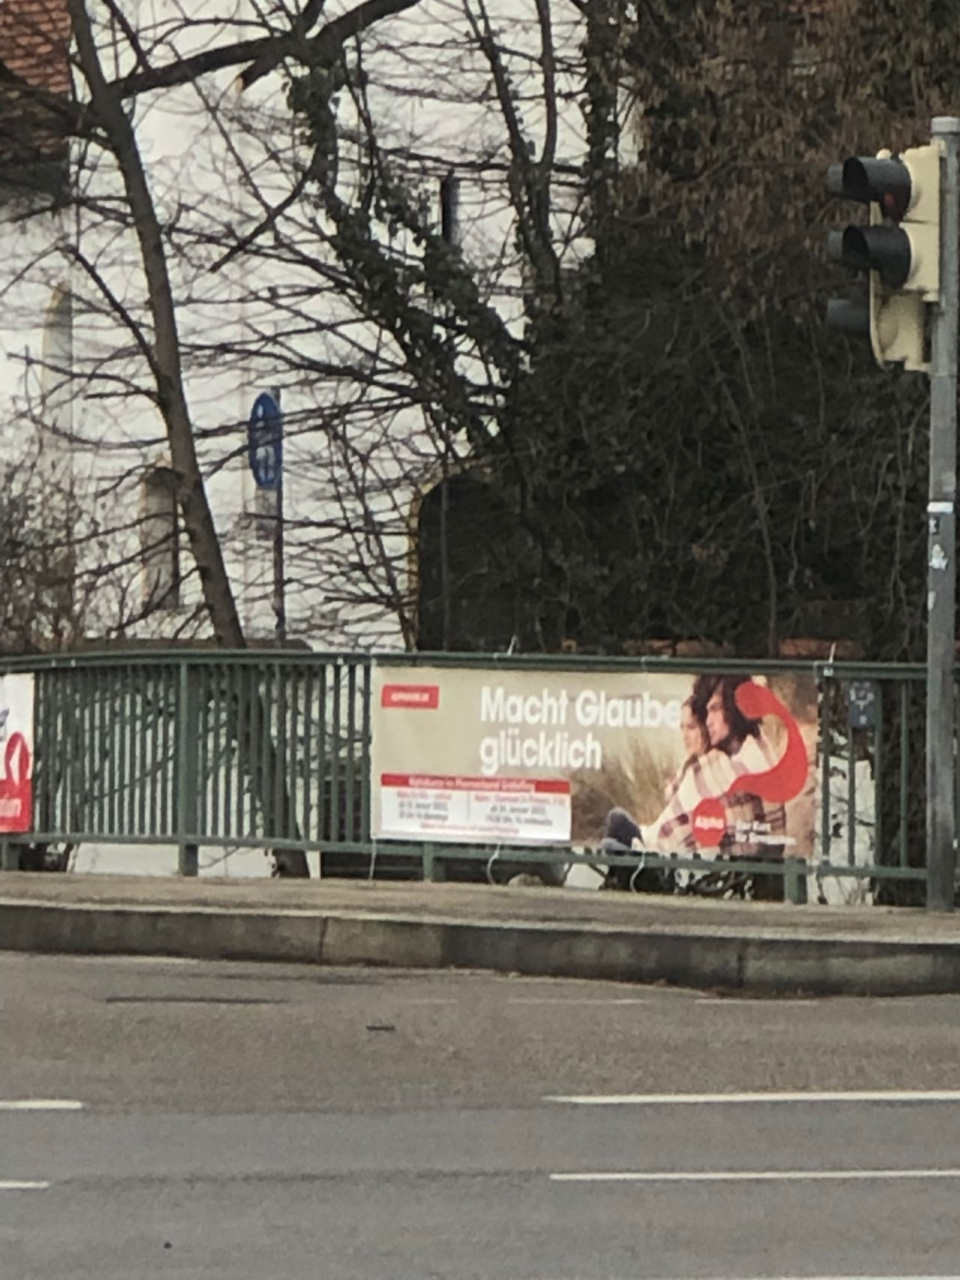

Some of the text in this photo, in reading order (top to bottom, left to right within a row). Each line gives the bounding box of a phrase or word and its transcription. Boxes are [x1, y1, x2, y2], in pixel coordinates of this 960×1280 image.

[480, 686, 682, 729] Macht Glaube
[479, 727, 601, 775] glücklich
